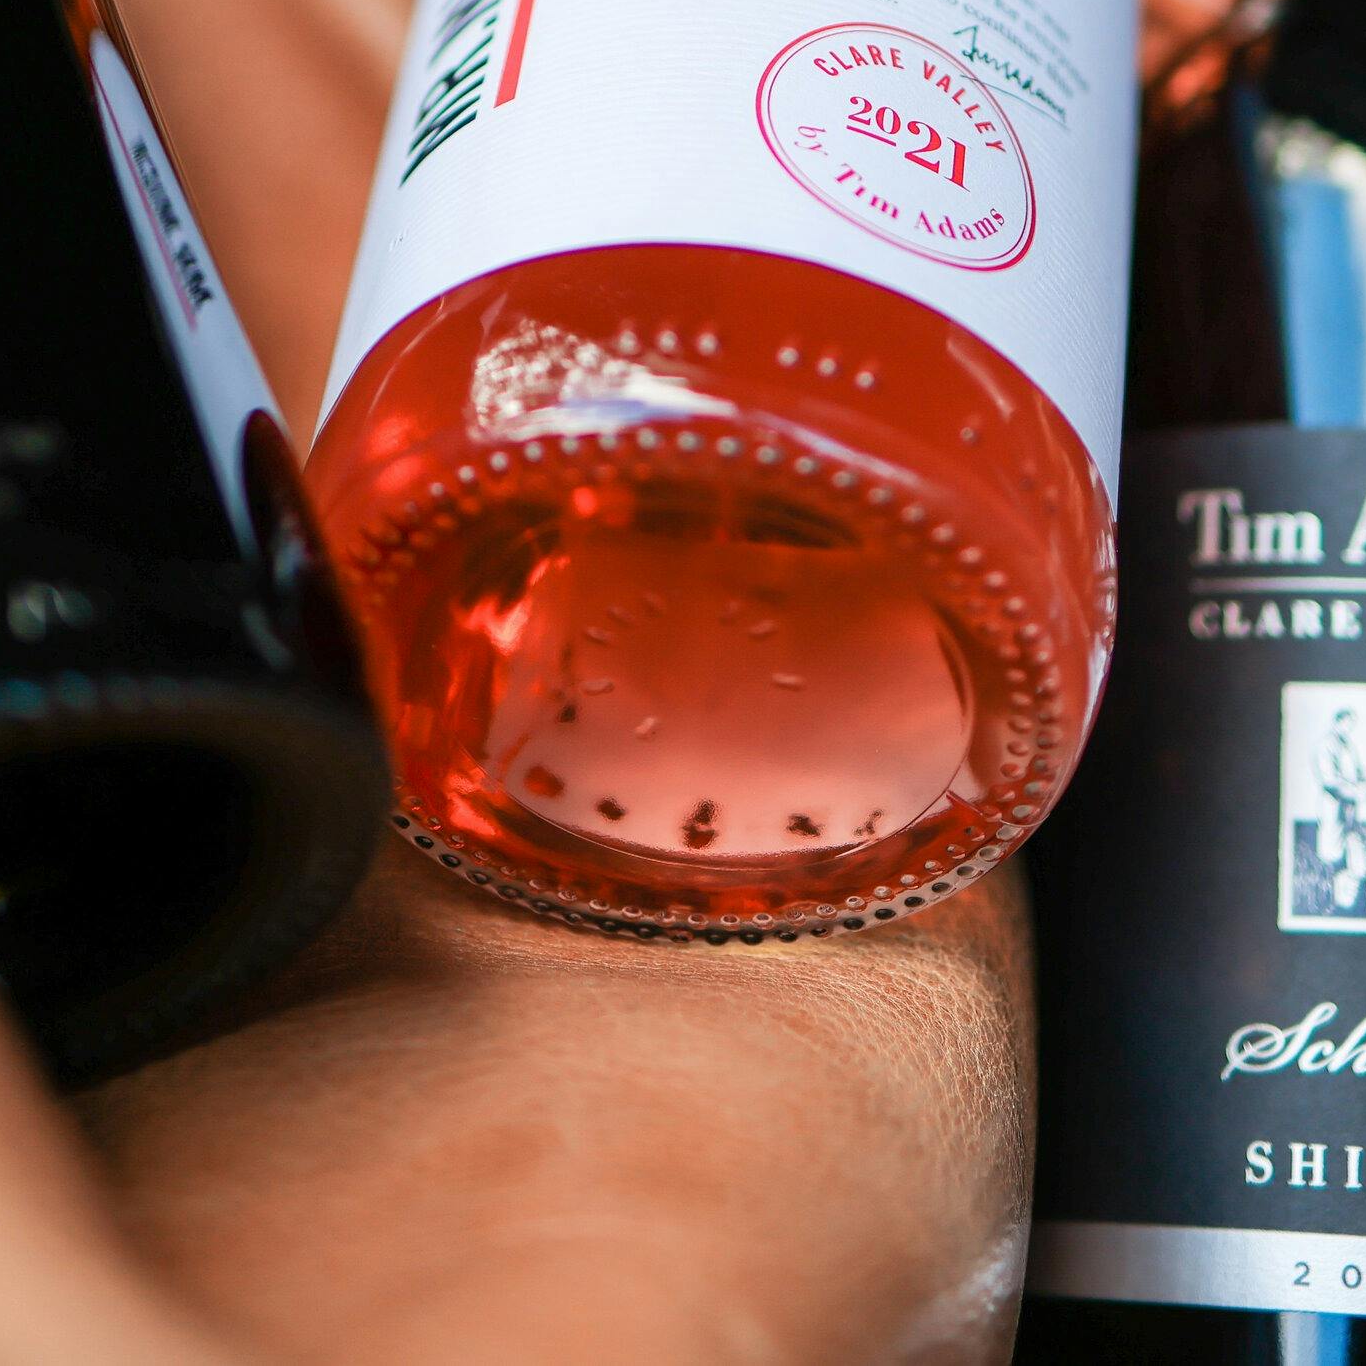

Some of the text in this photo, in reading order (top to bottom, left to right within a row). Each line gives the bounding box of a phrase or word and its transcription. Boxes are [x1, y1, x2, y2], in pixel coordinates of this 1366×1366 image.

[964, 2, 1042, 65] continue
[813, 44, 1007, 154] CLARE VALLEY
[794, 124, 1006, 241] by Tim Adams
[847, 96, 971, 192] 2021
[1179, 489, 1324, 568] Tim
[1190, 600, 1363, 641] CLARE
